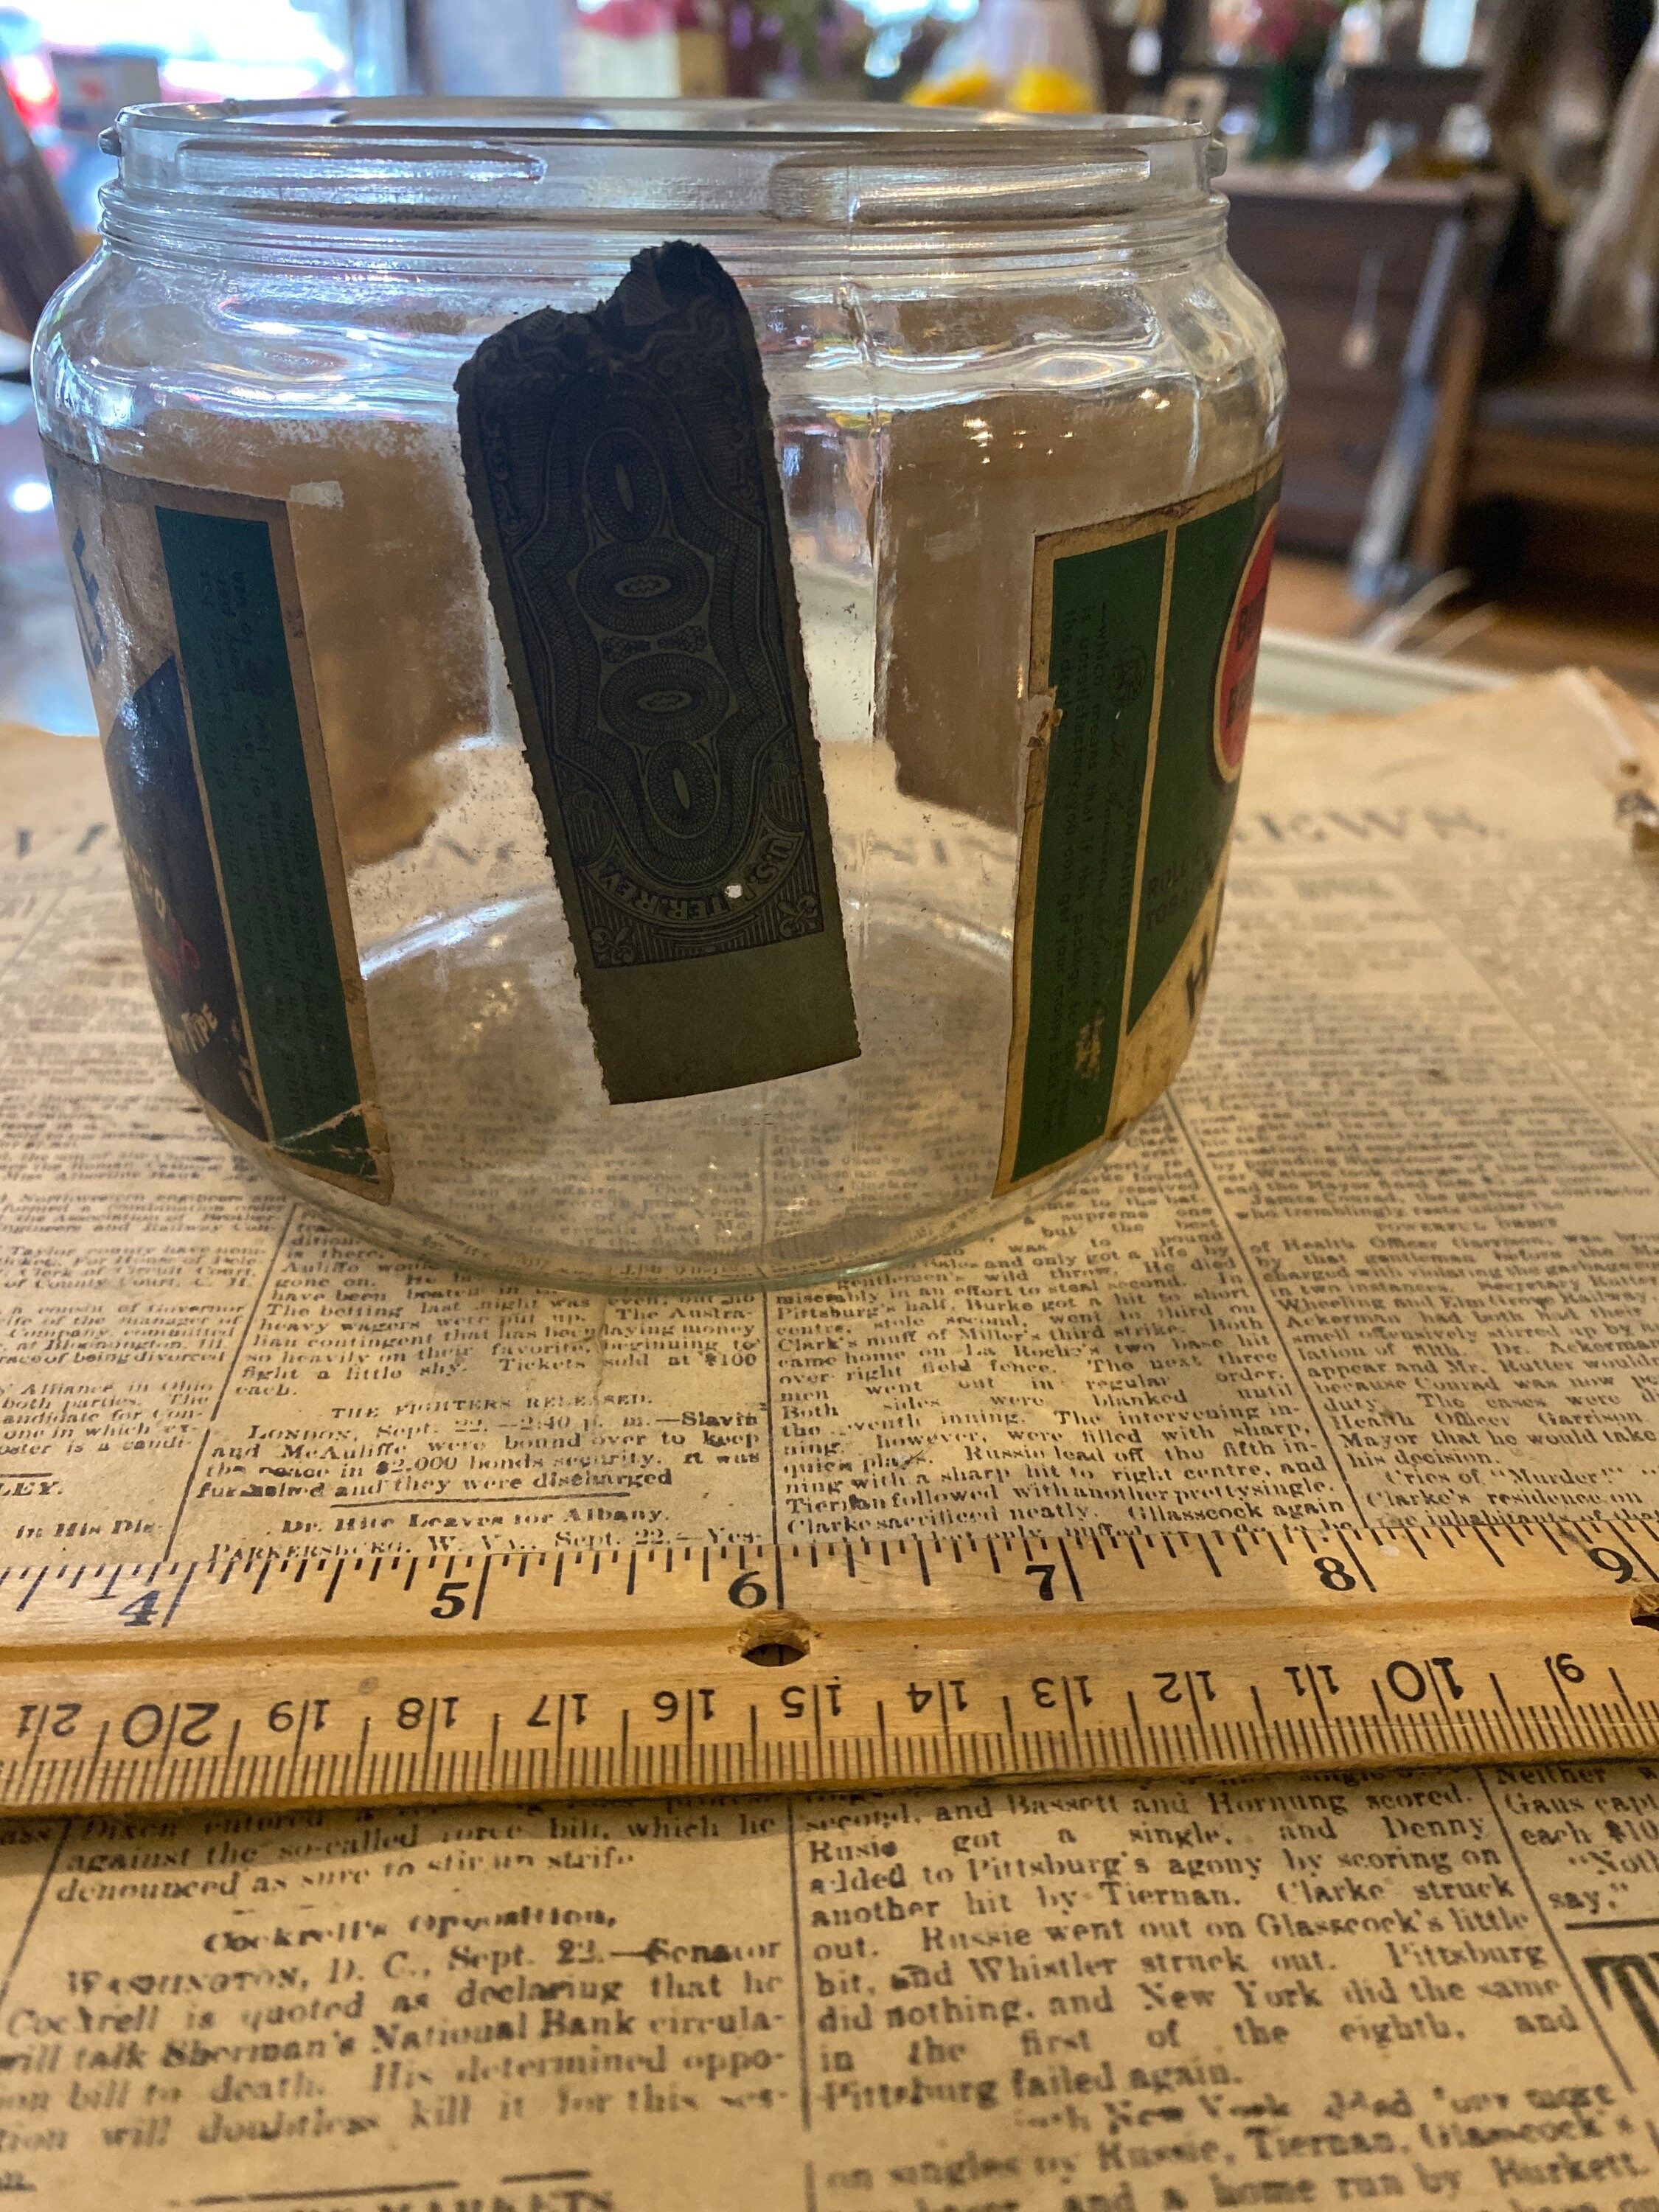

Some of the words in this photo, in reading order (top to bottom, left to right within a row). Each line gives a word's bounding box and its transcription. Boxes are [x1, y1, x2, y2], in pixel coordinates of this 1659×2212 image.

[615, 1308, 658, 1321] The
[682, 1324, 755, 1338] money
[242, 1366, 298, 1382] fight
[346, 1366, 402, 1381] little
[668, 1354, 689, 1366] at
[1307, 1363, 1386, 1380] appear
[1395, 1360, 1439, 1374] and
[782, 1402, 839, 1420] Both
[1416, 1393, 1465, 1408] The
[505, 1432, 581, 1450] bound
[661, 1431, 686, 1445] to
[1161, 1424, 1215, 1441] with
[1339, 1432, 1418, 1450] Mayor
[1431, 1429, 1481, 1445] that
[1114, 1447, 1144, 1462] off
[1164, 1445, 1204, 1461] the
[1222, 1440, 1276, 1458] fifth
[1283, 1438, 1317, 1453] in-
[1347, 1451, 1386, 1468] his
[1280, 1455, 1327, 1474] and
[463, 1478, 522, 1490] were
[1273, 1499, 1344, 1520] again
[1313, 1556, 1356, 1591] 8
[1588, 1547, 1634, 1583] 9
[728, 1571, 768, 1609] 6
[1025, 1565, 1056, 1601] 7
[118, 1590, 159, 1626] 4
[430, 1582, 470, 1619] 5
[952, 1830, 1001, 1853] got
[1279, 1816, 1338, 1841] and
[1381, 1815, 1483, 1840] Denny
[1520, 1820, 1592, 1846] each
[922, 1865, 954, 1885] to
[967, 1851, 1150, 1882] Pittsburg's
[1168, 1855, 1262, 1881] agony
[1281, 1848, 1322, 1878] by
[1338, 1846, 1453, 1875] scoring
[1461, 1848, 1501, 1865] on
[812, 1896, 940, 1927] another
[964, 1891, 1012, 1916] hit
[1036, 1885, 1077, 1916] by
[1413, 1873, 1514, 1901] struck
[813, 1936, 879, 1961] out.
[1045, 1918, 1124, 1941] went
[1139, 1918, 1192, 1938] out
[1206, 1921, 1245, 1939] on
[1448, 1906, 1528, 1933] little
[968, 1950, 1118, 1983] Whistler
[1140, 1946, 1248, 1973] struck
[650, 1972, 722, 1998] that
[818, 2002, 873, 2033] did
[1048, 1984, 1115, 2016] and
[1137, 1982, 1215, 2011] New
[1233, 1980, 1324, 2008] York
[1343, 1976, 1399, 2005] did
[1409, 1975, 1465, 2003] the
[540, 2008, 636, 2039] Bank
[821, 2048, 855, 2073] in
[1146, 2018, 1180, 2048] of
[1233, 2016, 1290, 2045] the
[1514, 2005, 1580, 2034] and
[1012, 2060, 1116, 2099] failed
